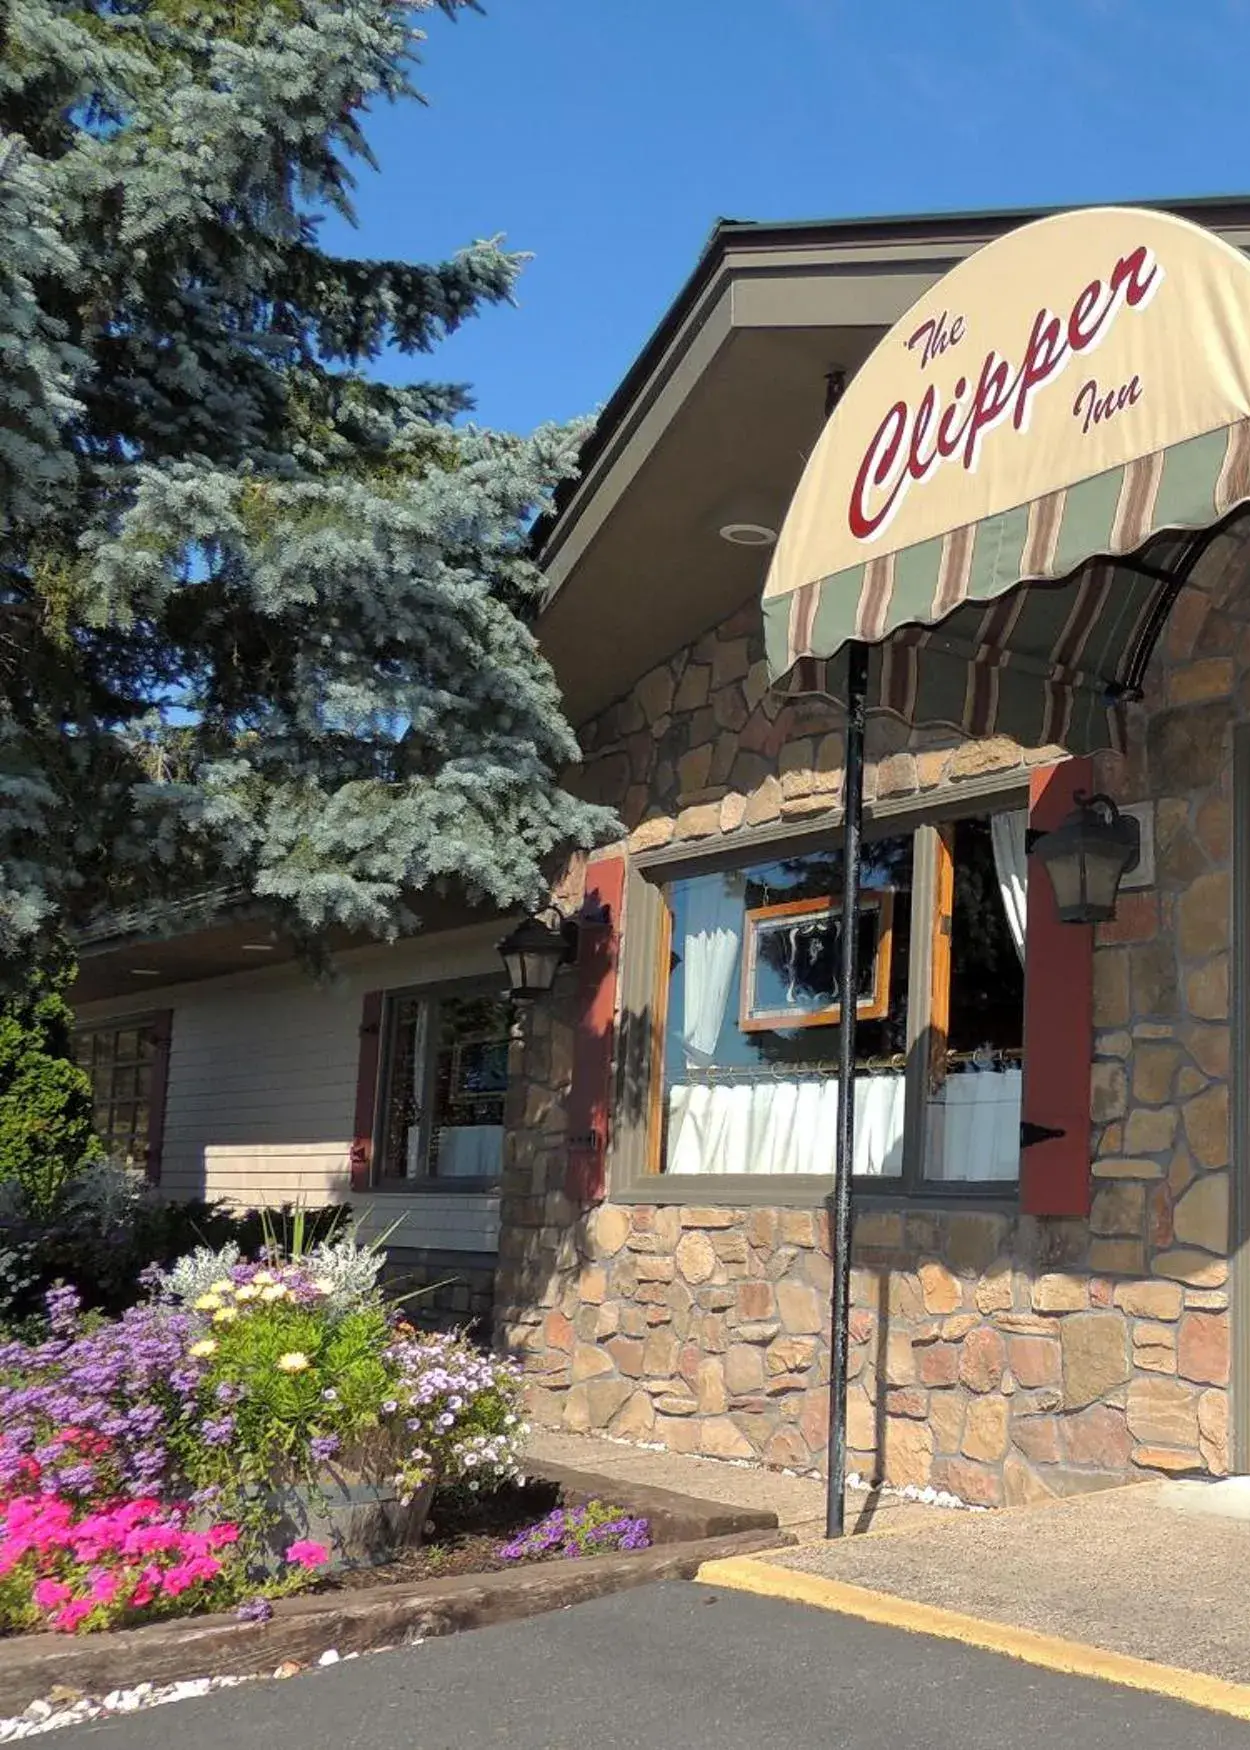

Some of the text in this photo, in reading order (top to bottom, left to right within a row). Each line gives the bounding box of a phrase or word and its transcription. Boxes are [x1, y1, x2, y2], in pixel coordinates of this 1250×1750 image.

[904, 310, 965, 369] The
[849, 246, 1160, 540] Clipper
[1073, 375, 1143, 434] Inn
